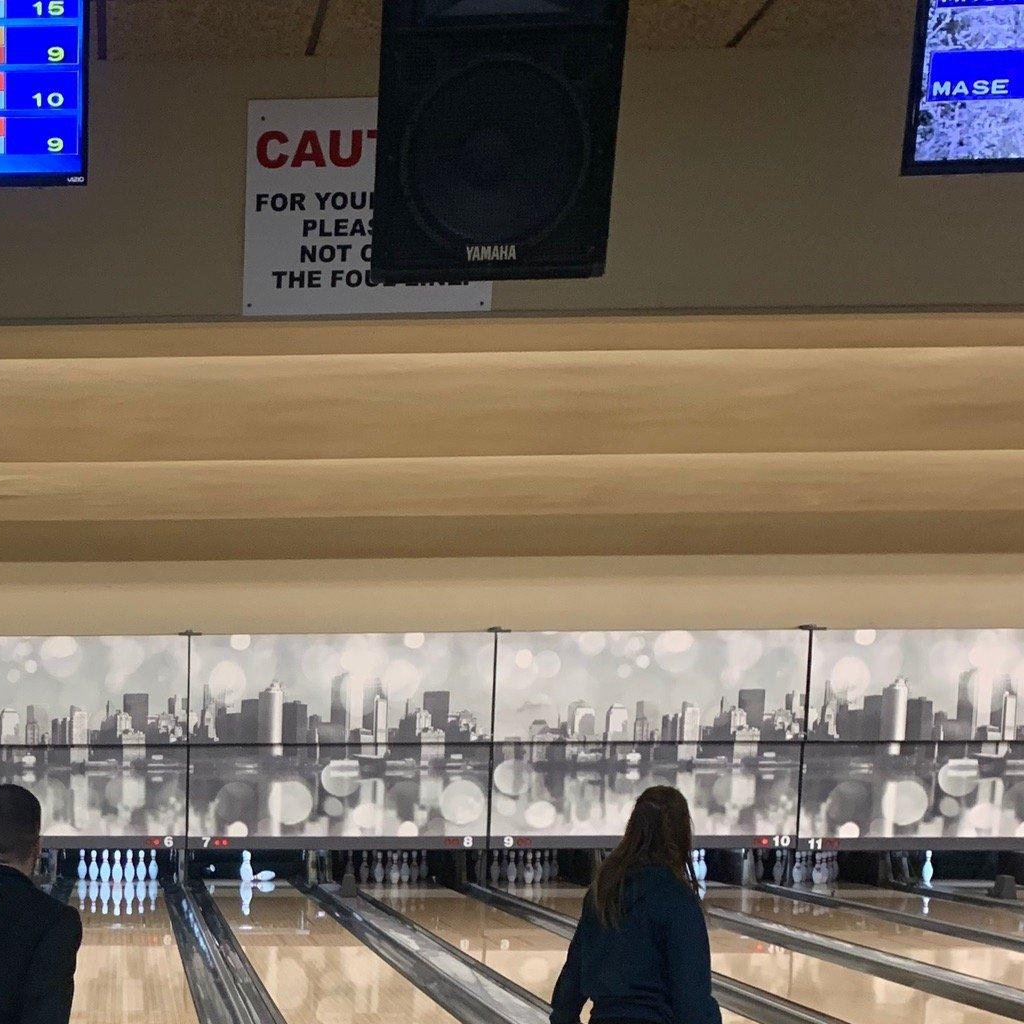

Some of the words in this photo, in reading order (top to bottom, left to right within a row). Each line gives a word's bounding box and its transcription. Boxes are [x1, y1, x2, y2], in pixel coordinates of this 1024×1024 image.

[32, 0, 65, 16] 15
[47, 46, 65, 62] 9
[932, 79, 1010, 96] MASE
[32, 92, 64, 108] 10
[47, 137, 64, 153] 9
[256, 193, 306, 212] FOR
[315, 191, 374, 211] YOU
[300, 245, 352, 263] NOT
[467, 245, 517, 261] YAMAHA
[272, 270, 322, 289] THE
[163, 836, 174, 848] 6
[201, 837, 211, 848] 7
[463, 836, 473, 848] 8
[503, 836, 514, 848] 9
[772, 835, 791, 847] 10
[808, 838, 823, 850] 11
